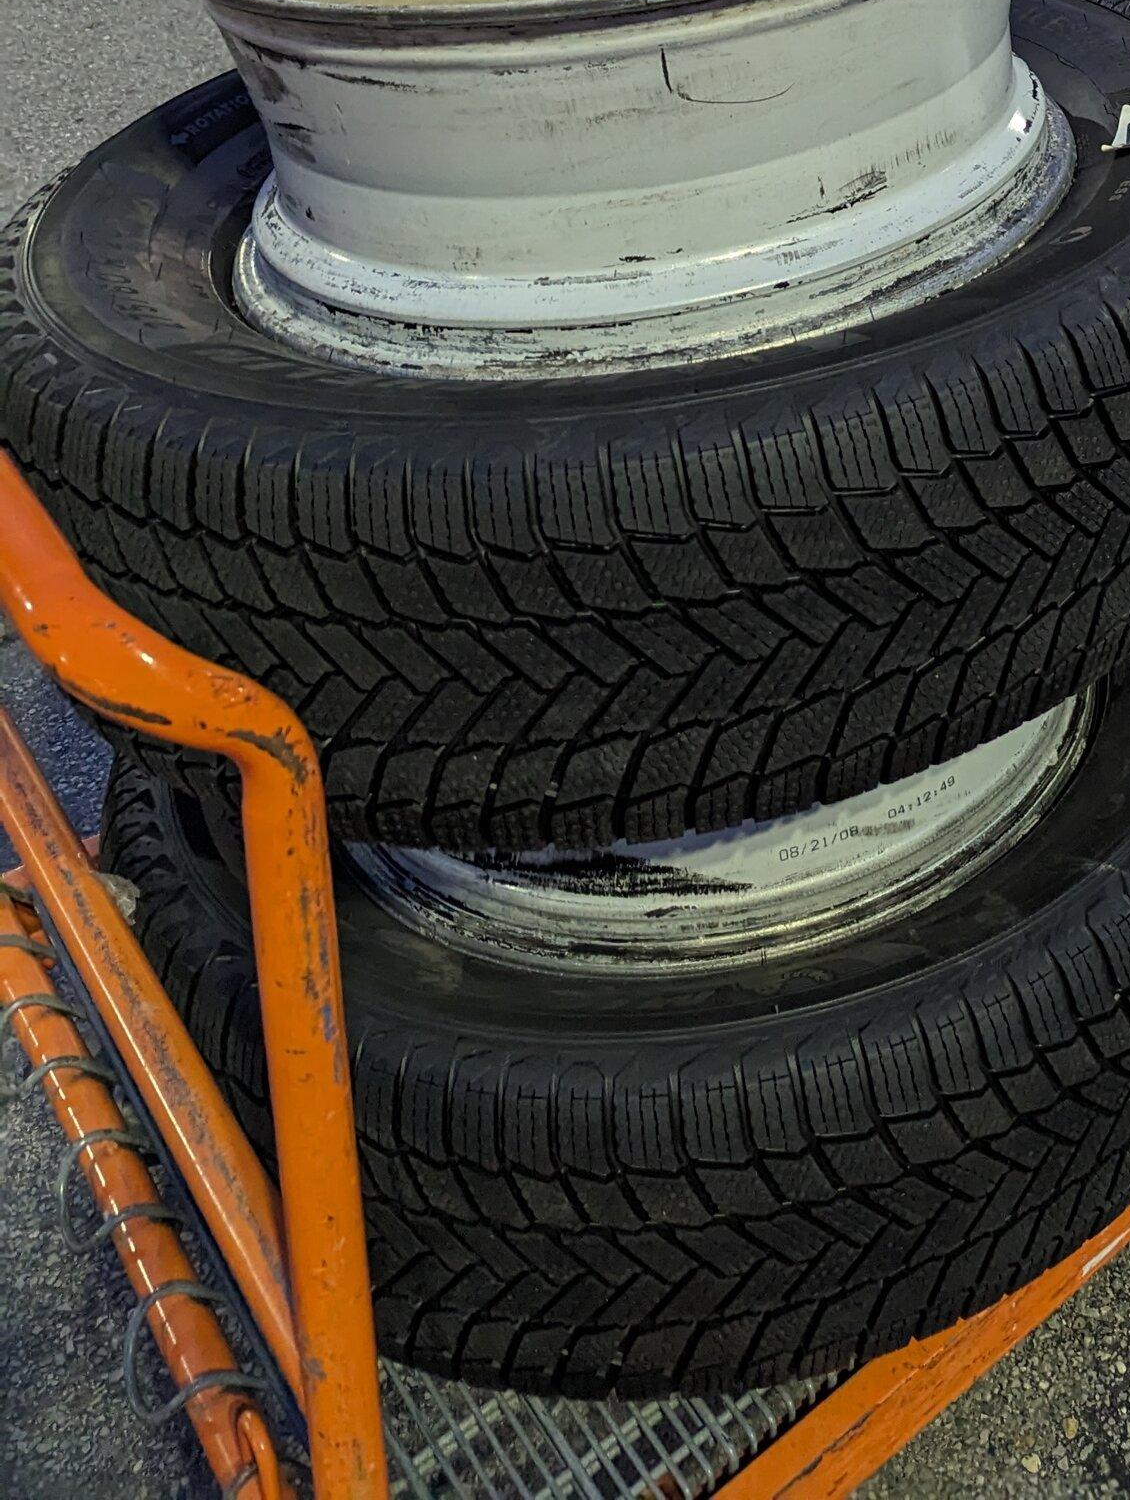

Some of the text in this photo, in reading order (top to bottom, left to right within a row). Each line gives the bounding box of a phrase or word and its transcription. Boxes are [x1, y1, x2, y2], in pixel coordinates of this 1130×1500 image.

[184, 95, 249, 136] ROTATIO
[779, 775, 956, 862] 08/21/08 04:12:49
